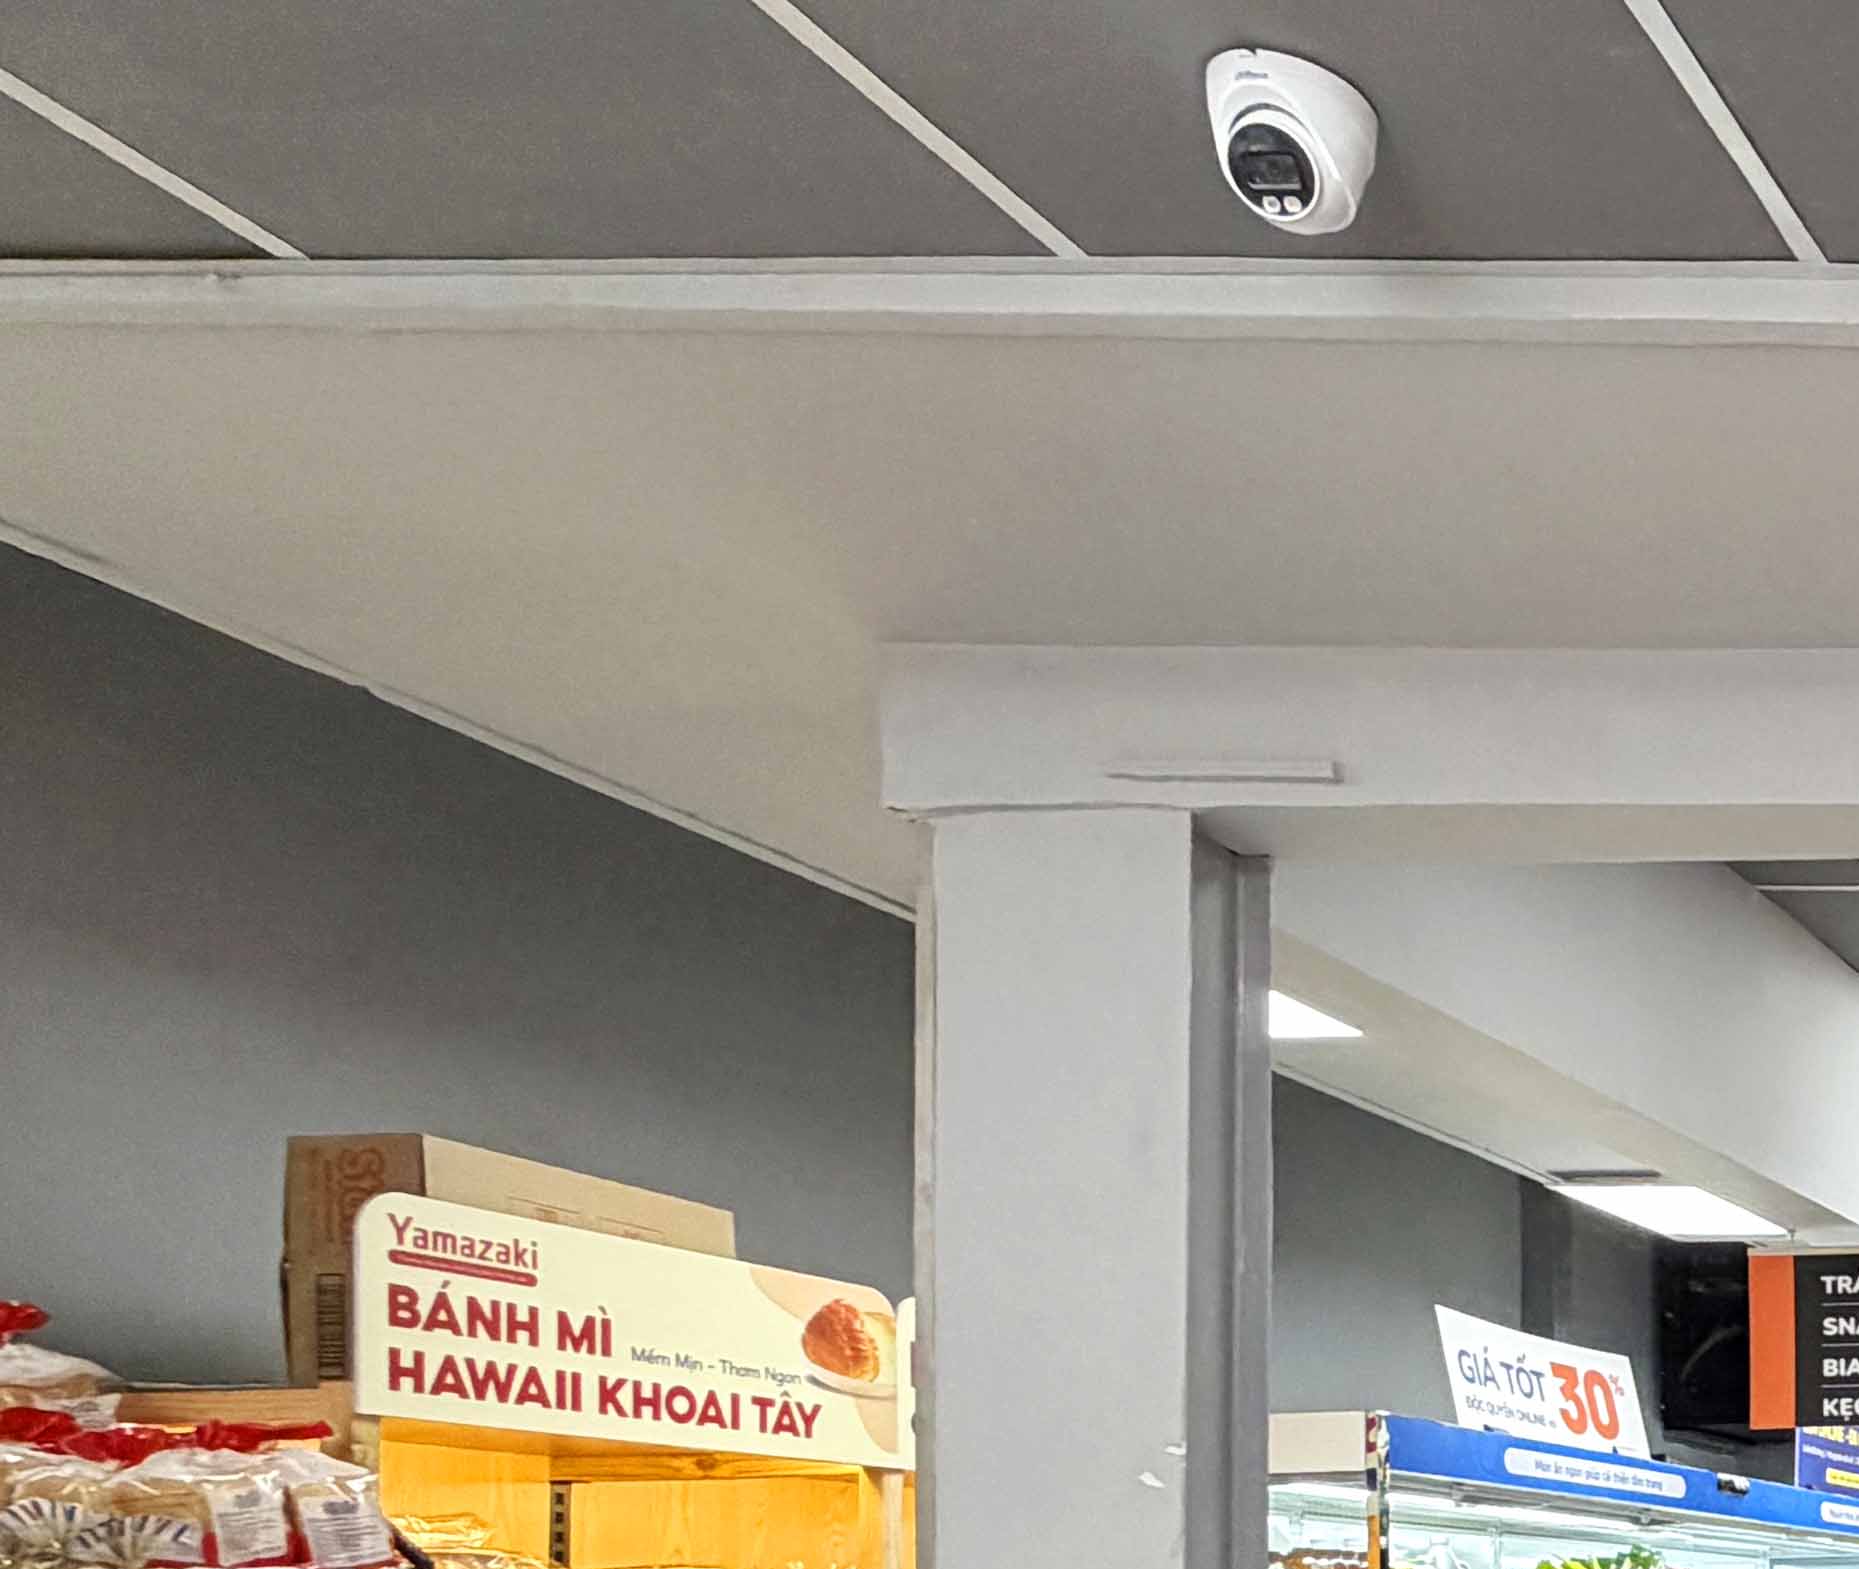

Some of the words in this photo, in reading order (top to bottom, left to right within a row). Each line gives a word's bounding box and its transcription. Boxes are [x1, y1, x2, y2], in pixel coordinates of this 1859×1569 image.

[387, 1213, 539, 1270] Yamazaki
[387, 1281, 541, 1347] BÁNH
[556, 1306, 613, 1357] MÌ
[387, 1347, 583, 1412] HAWAII
[600, 1375, 743, 1431] KHOAI
[751, 1391, 822, 1439] TÂY
[1458, 1346, 1500, 1391] GIÁ
[1500, 1353, 1545, 1402] TỐT
[1550, 1361, 1619, 1440] 30
